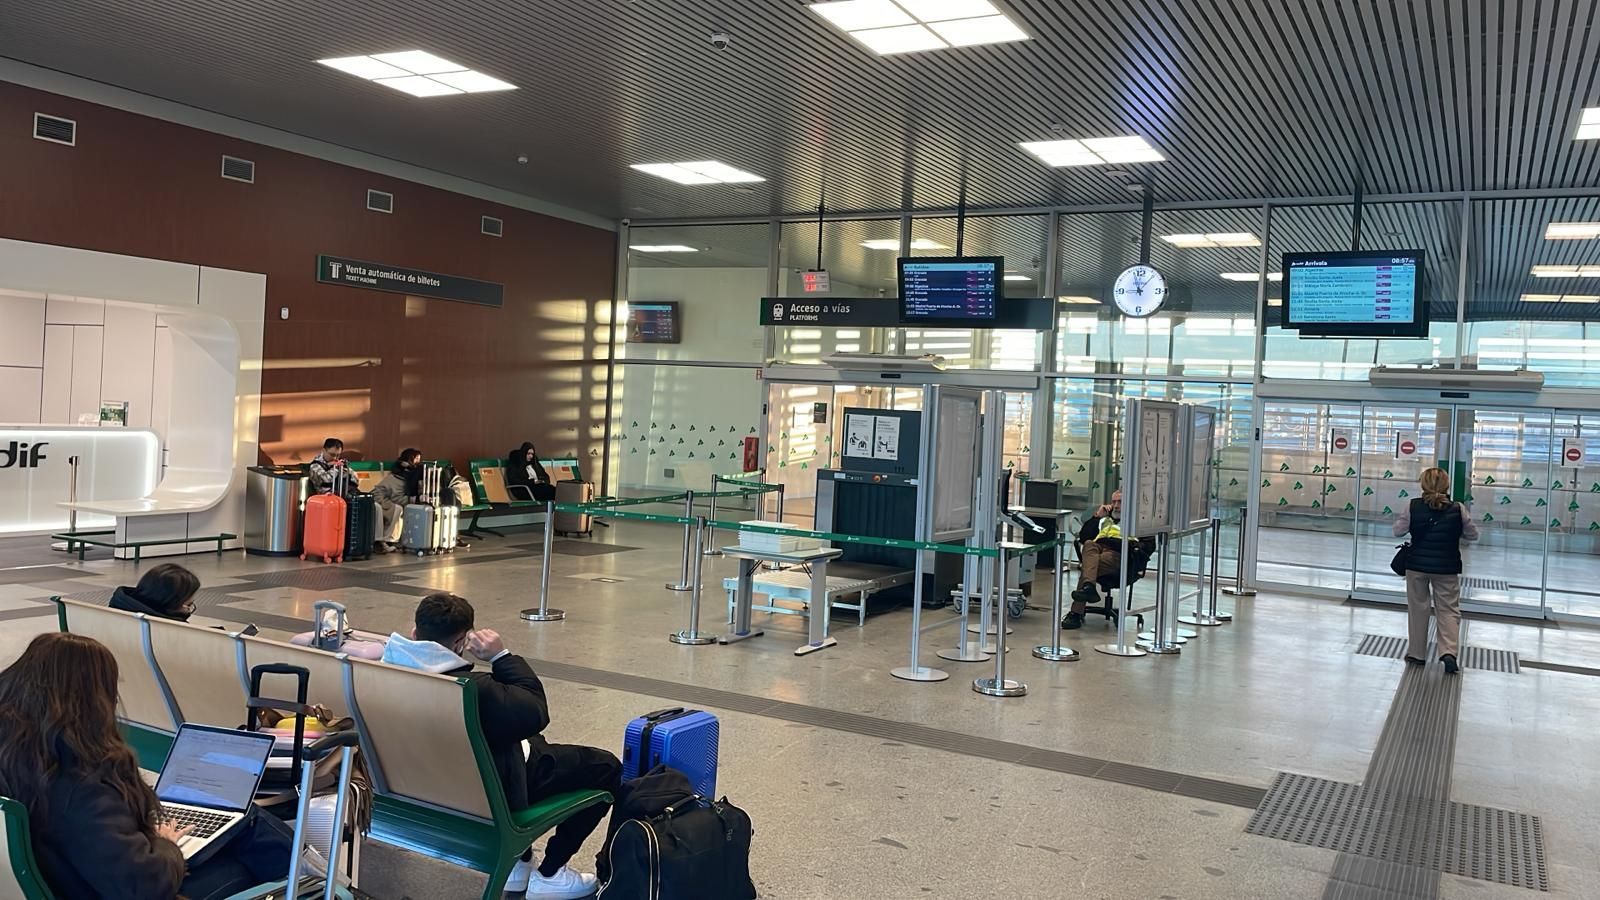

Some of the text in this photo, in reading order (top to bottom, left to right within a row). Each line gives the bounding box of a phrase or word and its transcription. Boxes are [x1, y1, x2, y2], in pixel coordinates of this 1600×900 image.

[346, 264, 440, 287] Venta automática de billetes
[790, 304, 820, 313] Acceso
[832, 303, 850, 313] vías
